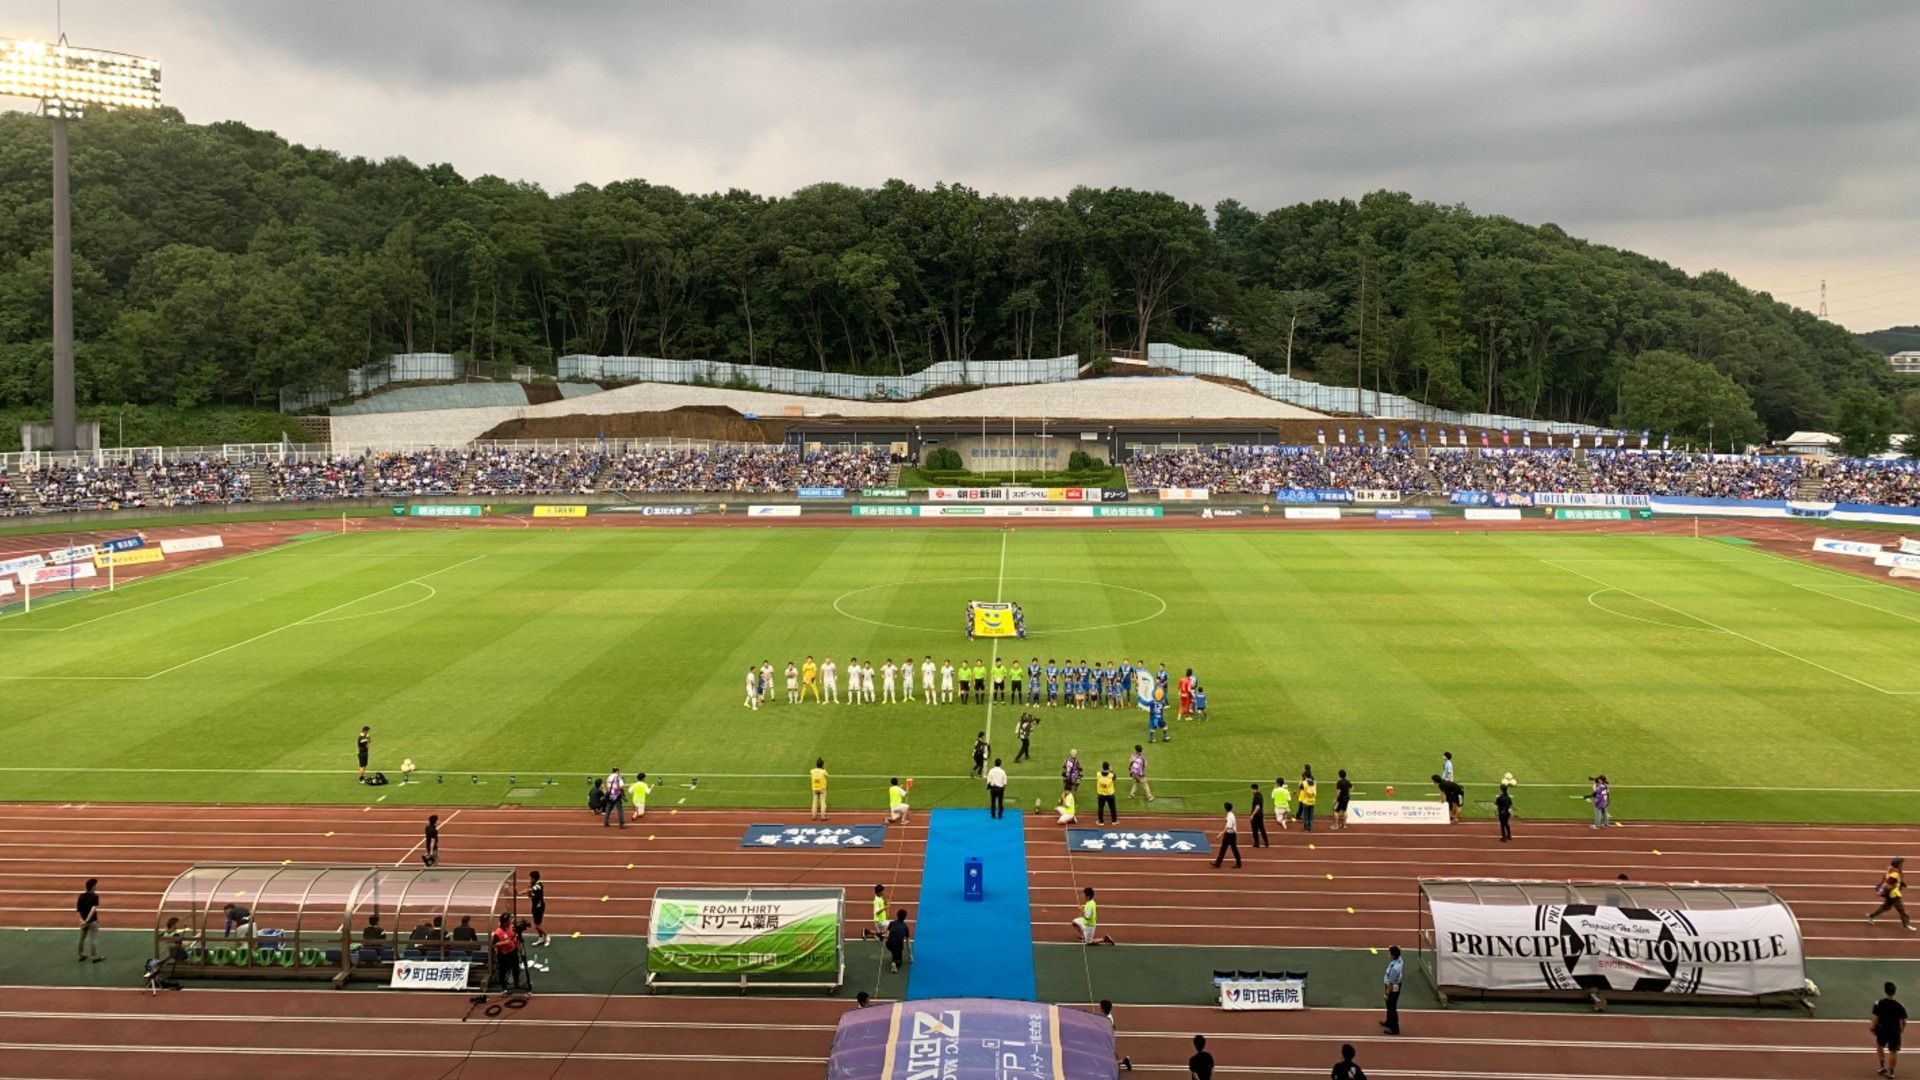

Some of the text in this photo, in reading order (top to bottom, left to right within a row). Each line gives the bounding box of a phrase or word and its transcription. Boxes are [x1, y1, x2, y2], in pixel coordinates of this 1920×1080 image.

[957, 489, 1001, 499] 朝日新聞
[1605, 495, 1616, 505] LA
[860, 506, 912, 516] 明治安田生命
[1101, 506, 1154, 517] 明治安田生命
[1565, 509, 1621, 520] 明治安田生命
[703, 905, 781, 914] FROM THIRTY
[702, 915, 779, 929] ドリーム薬局
[1448, 932, 1787, 963] PRINCIPLE AUTOMOBILE
[1599, 961, 1623, 969] SINCE
[412, 967, 465, 982] 町田病院
[1243, 989, 1299, 1003] 町田病院
